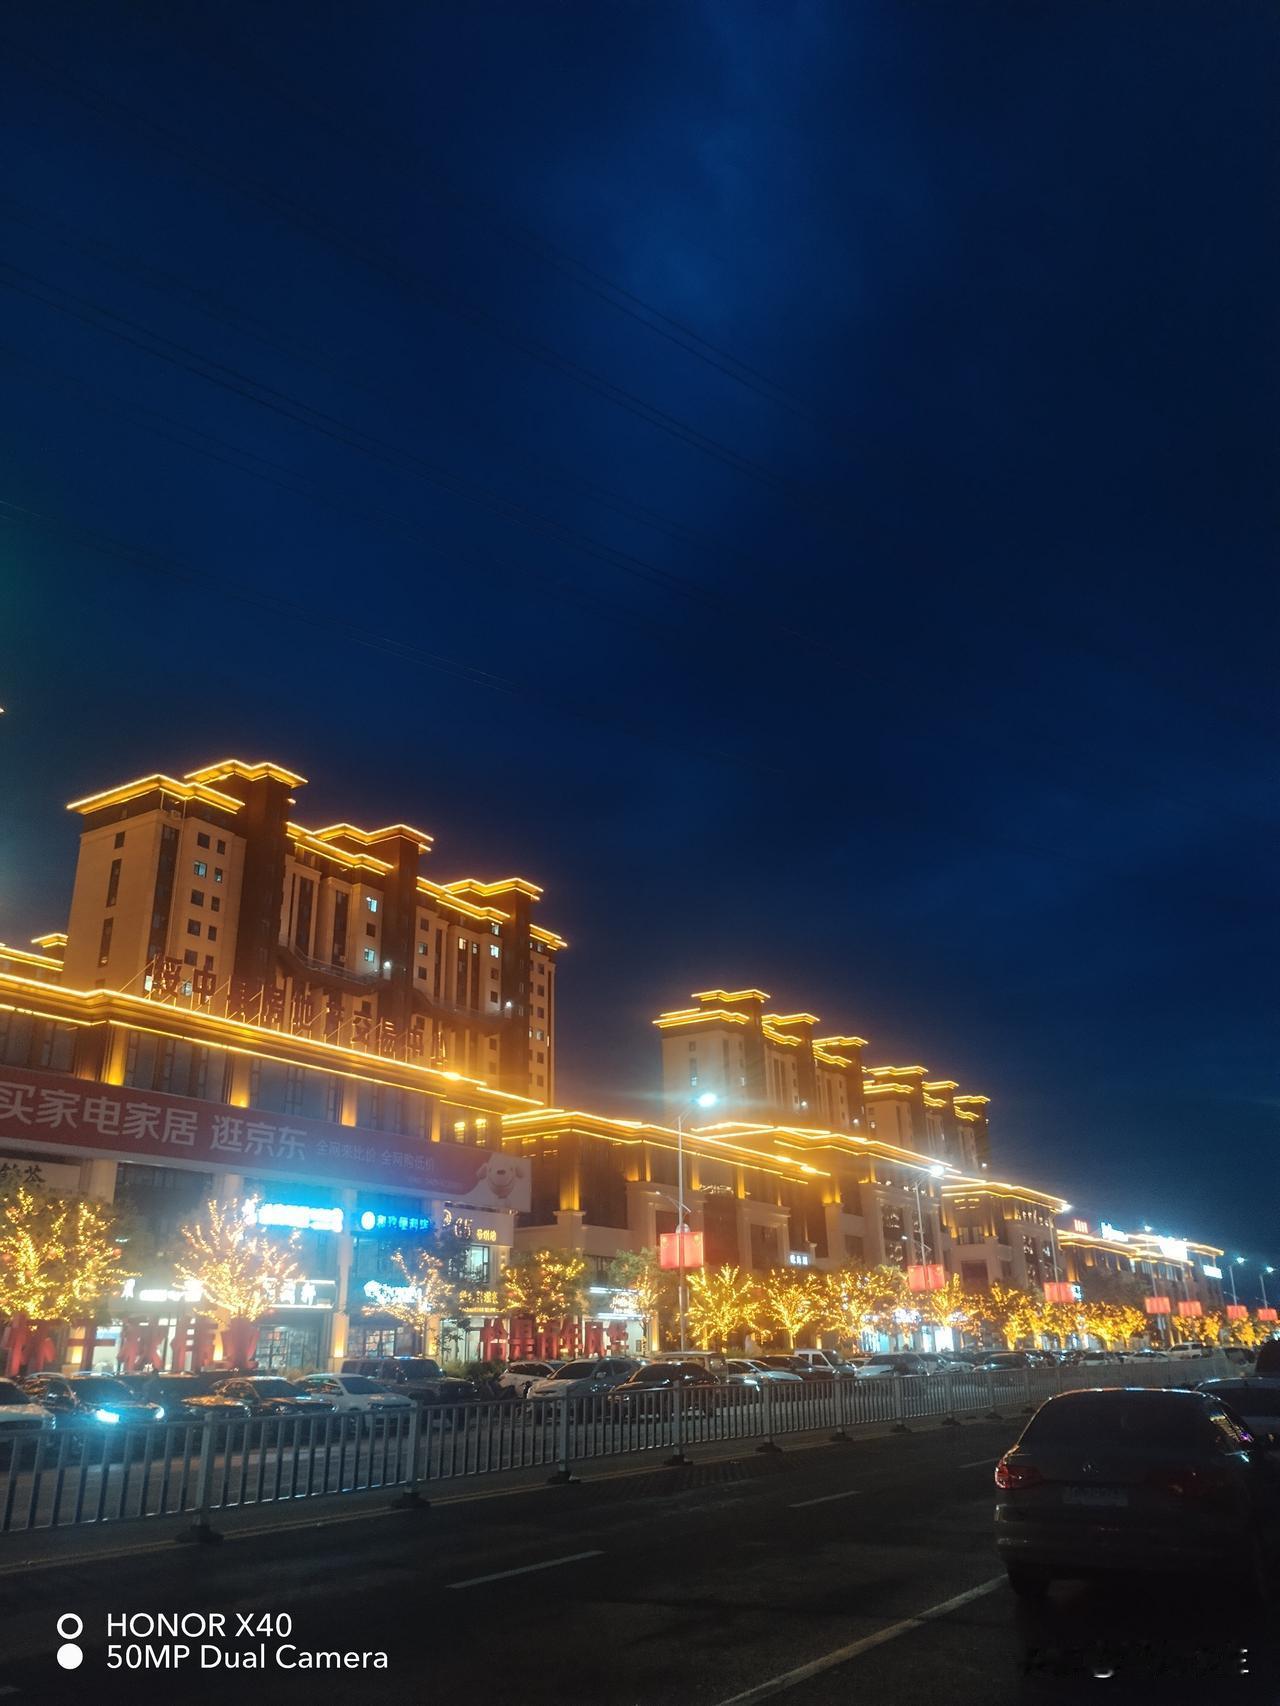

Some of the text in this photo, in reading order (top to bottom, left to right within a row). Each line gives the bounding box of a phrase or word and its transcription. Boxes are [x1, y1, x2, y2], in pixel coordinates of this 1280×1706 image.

[0, 1081, 199, 1147] 买家电家居
[210, 1114, 308, 1161] 逛京东
